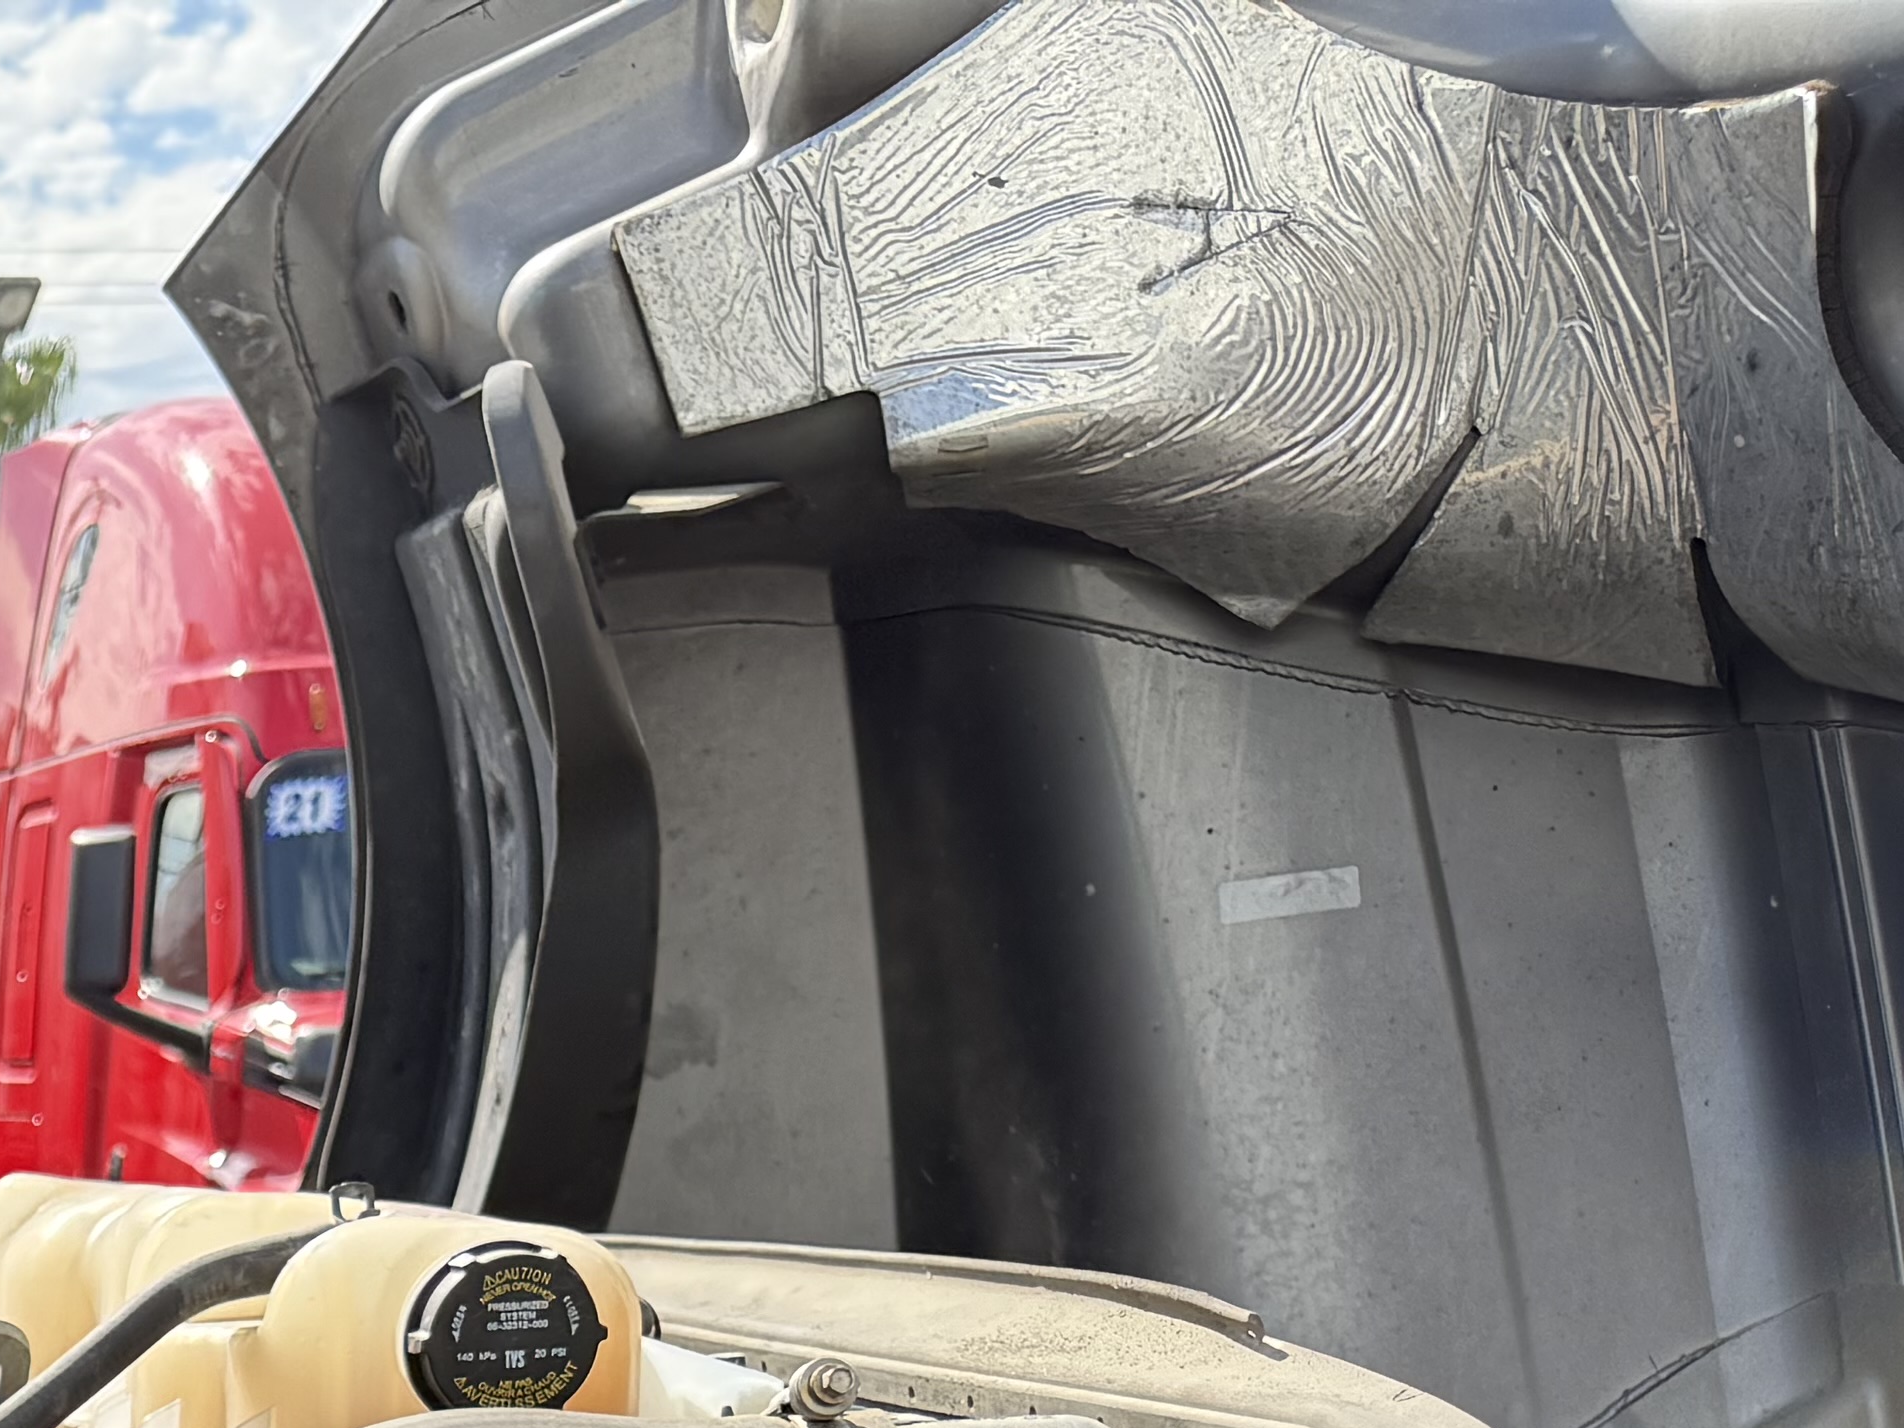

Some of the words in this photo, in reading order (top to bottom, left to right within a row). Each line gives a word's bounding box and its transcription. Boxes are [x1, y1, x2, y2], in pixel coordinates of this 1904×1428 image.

[496, 1266, 552, 1286] CAUTION
[487, 1300, 549, 1312] PRESSURIZED
[500, 1309, 537, 1322] SYSTEM
[456, 1352, 475, 1362] 140
[504, 1349, 527, 1369] TVS
[534, 1347, 547, 1359] 20
[550, 1346, 567, 1358] PSI
[462, 1356, 579, 1408] AVERTISSEMENT
